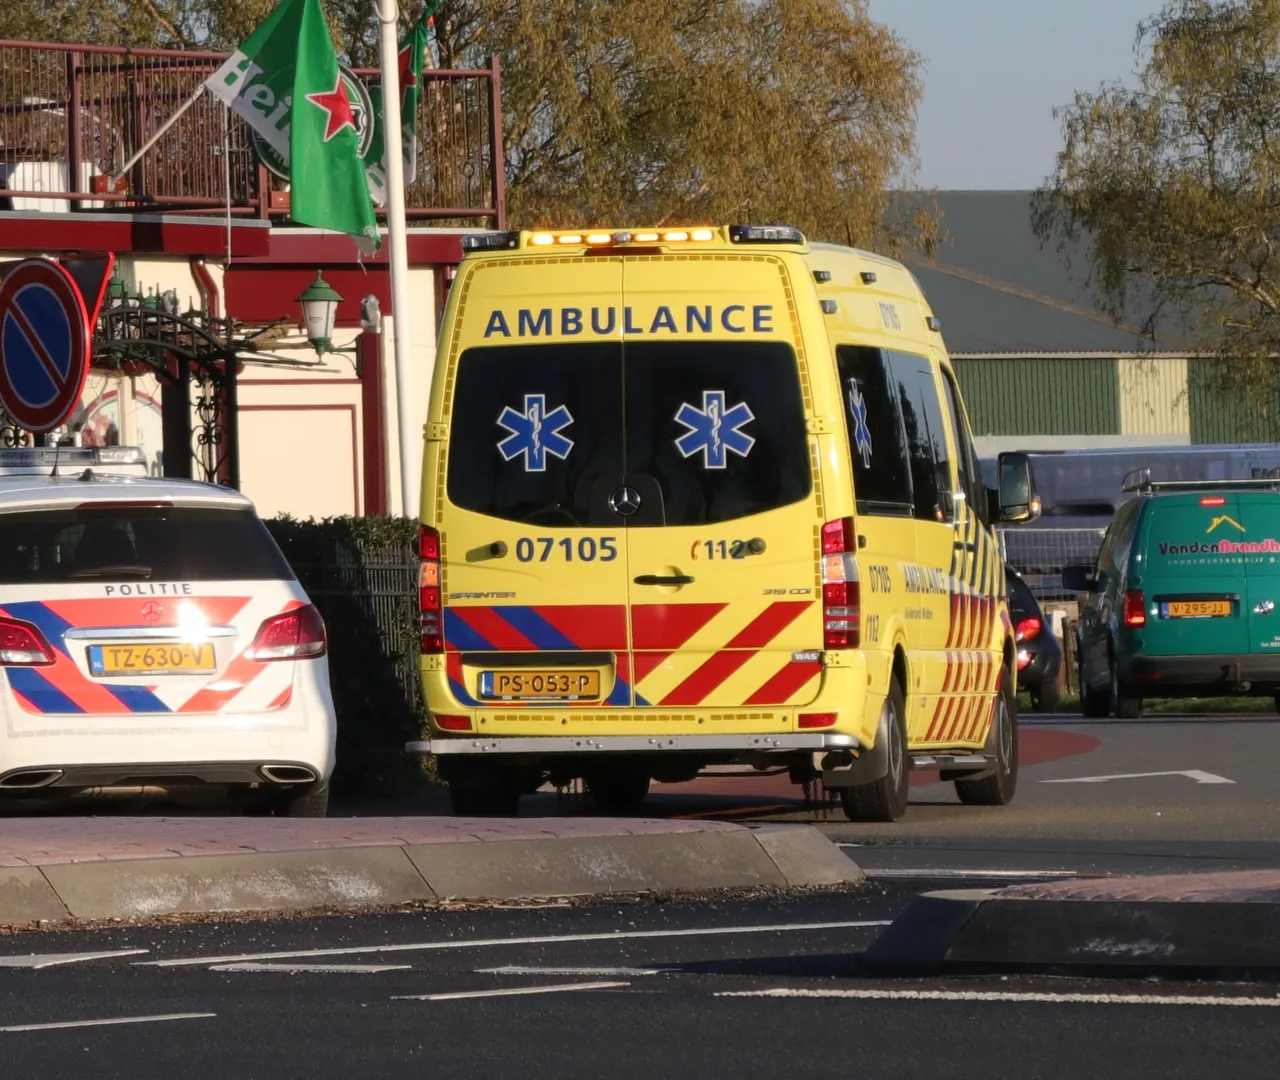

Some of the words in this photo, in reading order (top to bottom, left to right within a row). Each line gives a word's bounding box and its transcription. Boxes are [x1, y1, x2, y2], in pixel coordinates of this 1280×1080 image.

[483, 304, 775, 338] AMBULANCE
[516, 537, 618, 562] 07105
[105, 583, 192, 596] POLITIE
[449, 591, 516, 600] SPRINTER
[1172, 603, 1224, 614] V-295-JJ
[108, 646, 204, 669] TZ-630-V
[795, 652, 818, 661] WAS
[499, 675, 590, 694] PS-053-P
